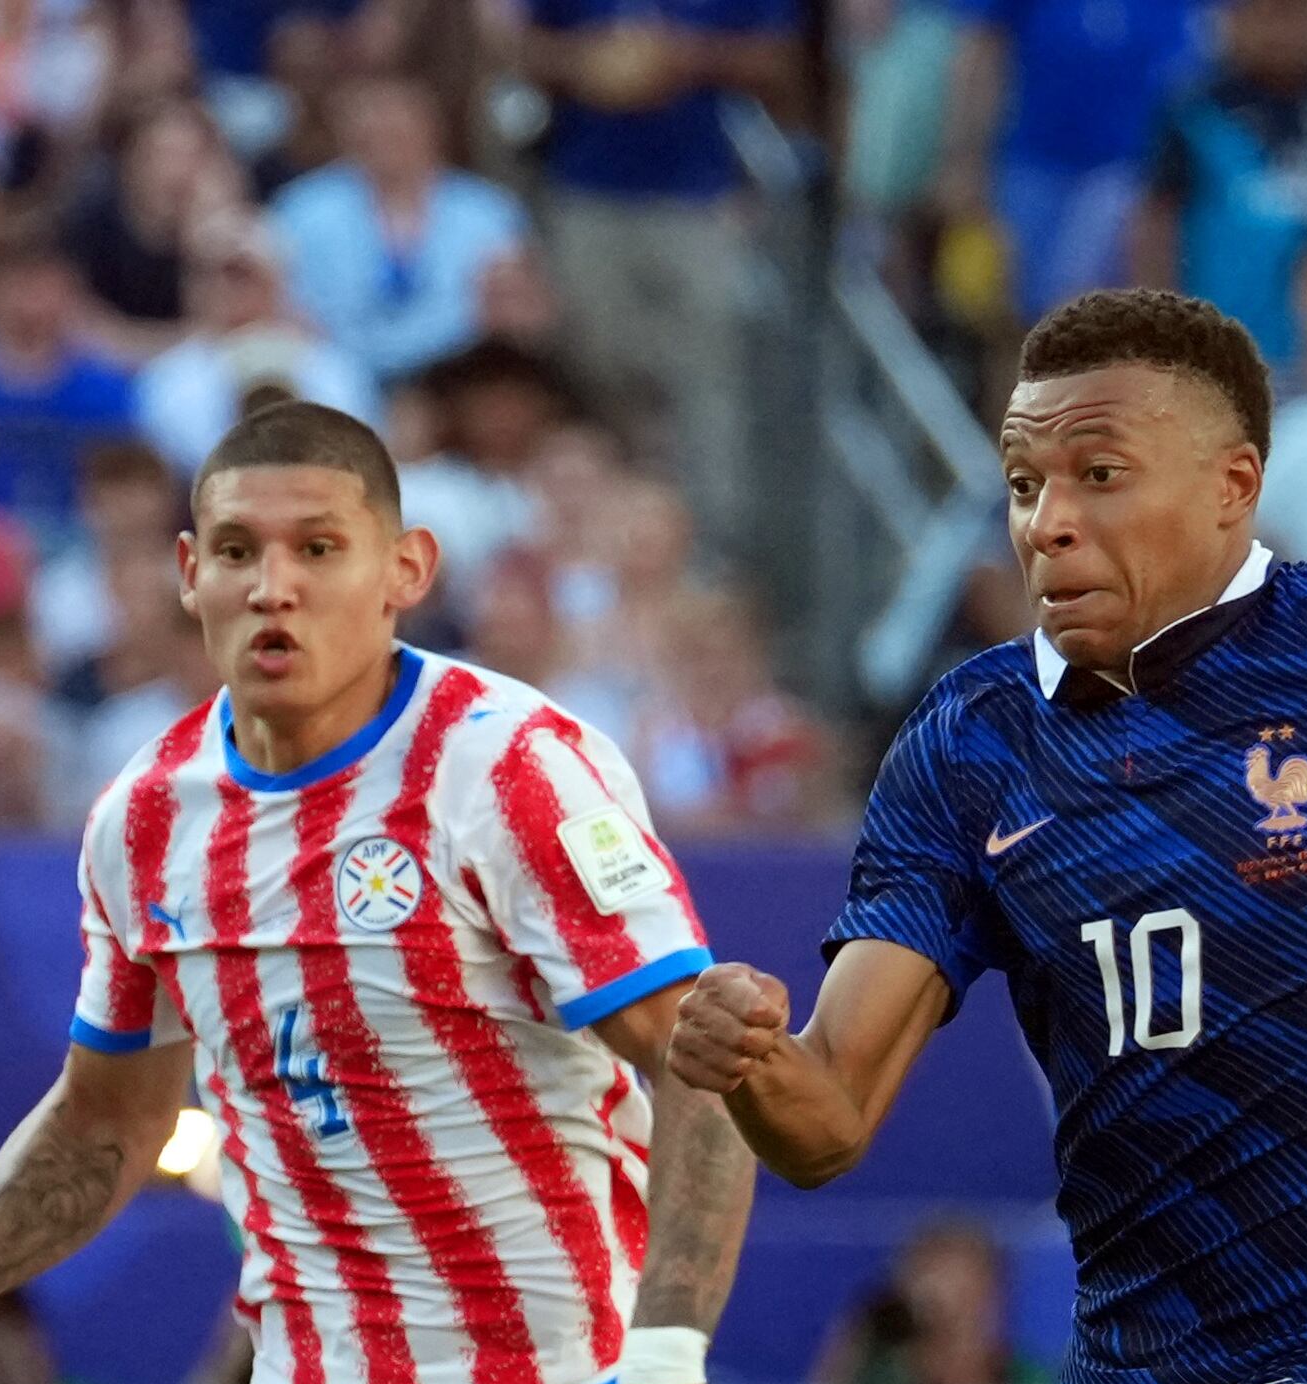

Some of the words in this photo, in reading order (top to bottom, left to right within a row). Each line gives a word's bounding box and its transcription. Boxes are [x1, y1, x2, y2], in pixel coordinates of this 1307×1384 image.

[363, 842, 388, 859] APF
[1267, 833, 1303, 849] FFF
[1081, 907, 1201, 1057] 10
[273, 1002, 353, 1139] 4
